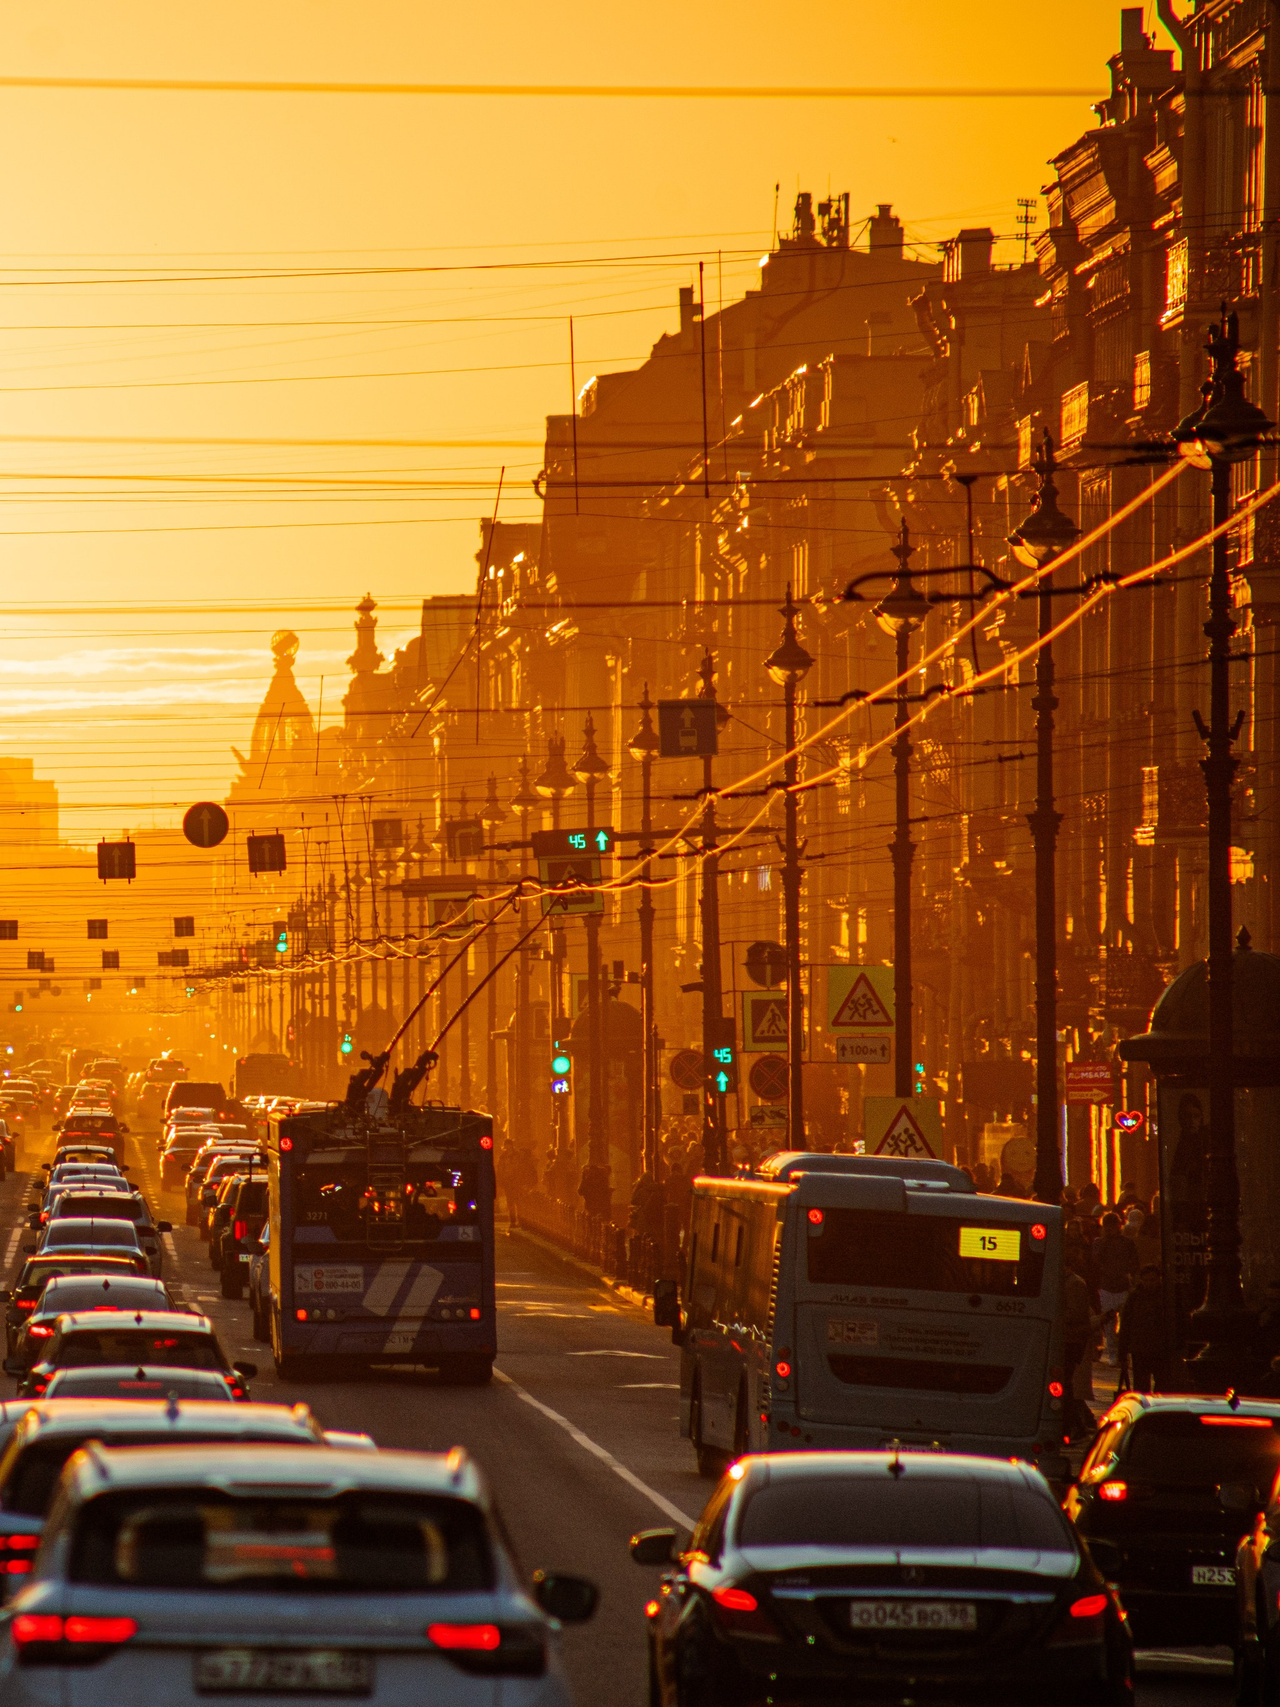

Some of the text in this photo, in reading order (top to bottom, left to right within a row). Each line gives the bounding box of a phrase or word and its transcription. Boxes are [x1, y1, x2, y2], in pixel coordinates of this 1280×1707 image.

[568, 833, 586, 849] 45
[713, 1047, 732, 1063] 45
[306, 1211, 328, 1221] 3271
[979, 1236, 998, 1251] 15
